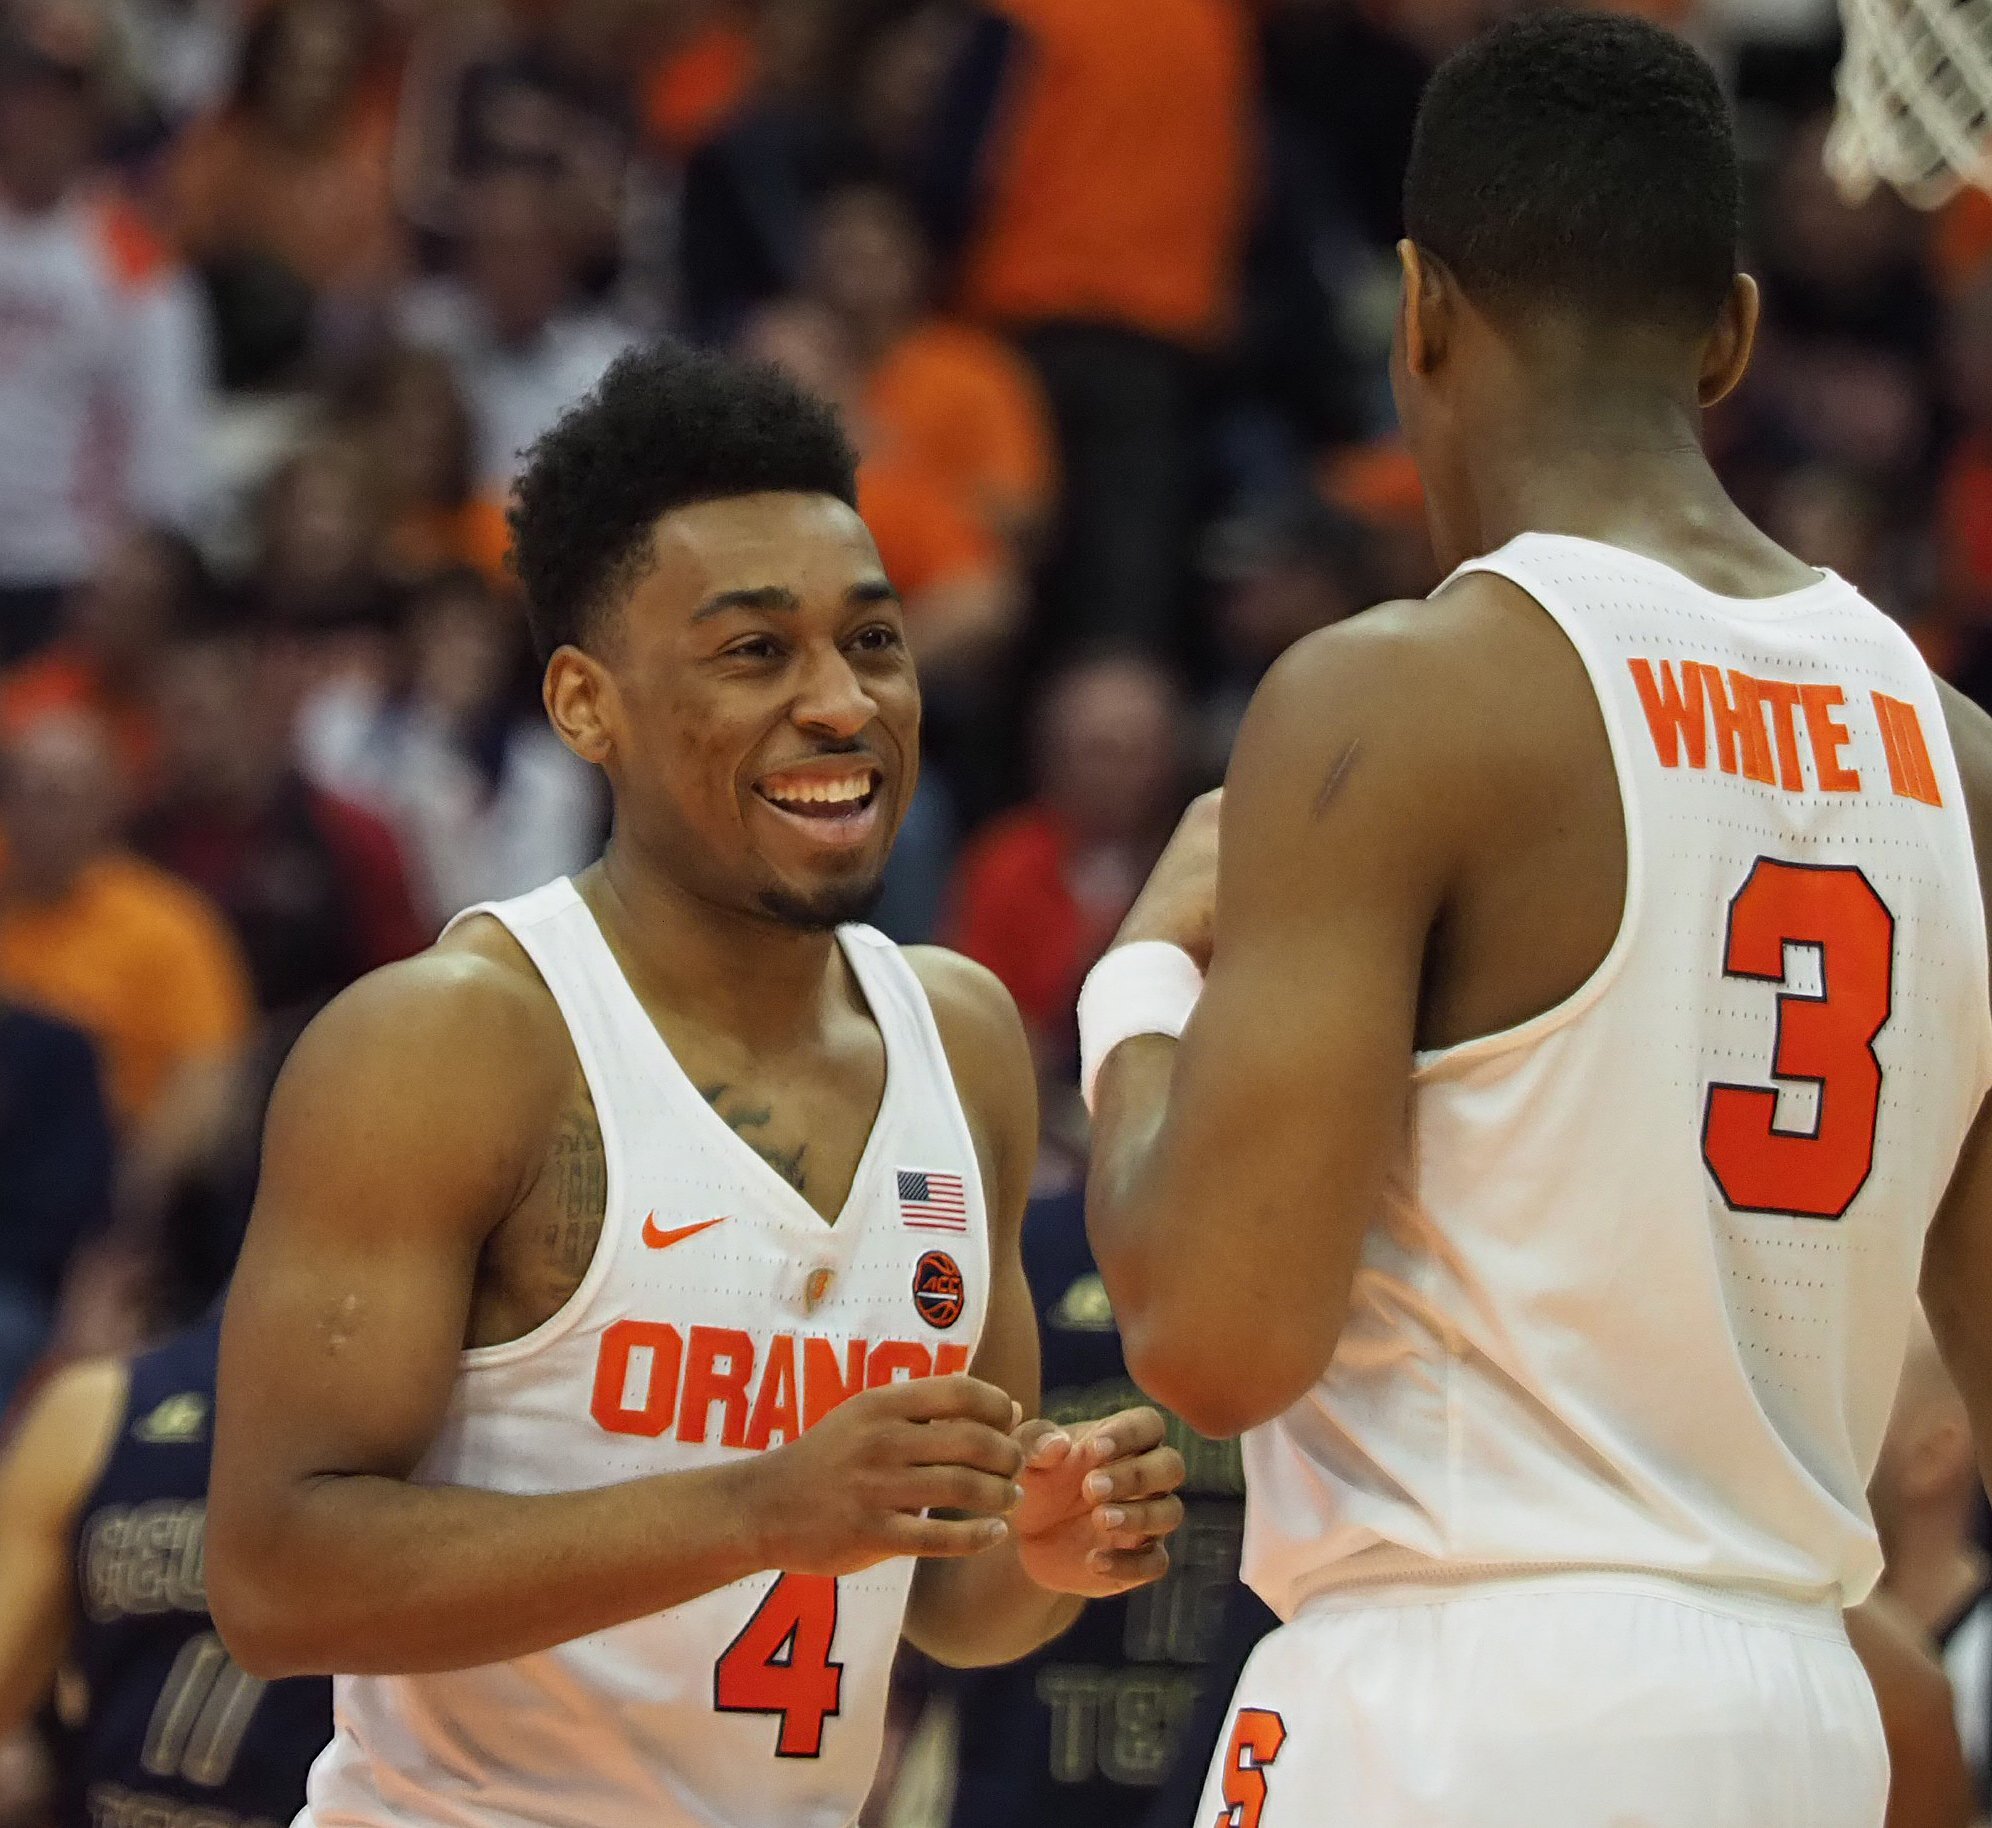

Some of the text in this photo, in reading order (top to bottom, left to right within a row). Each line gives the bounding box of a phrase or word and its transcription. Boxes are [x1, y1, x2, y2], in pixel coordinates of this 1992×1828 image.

[1627, 658, 1860, 792] WHITE
[1702, 855, 1894, 1220] 3
[923, 1276, 961, 1295] ACC
[714, 1571, 844, 1758] 4
[1213, 1707, 1287, 1828] S
